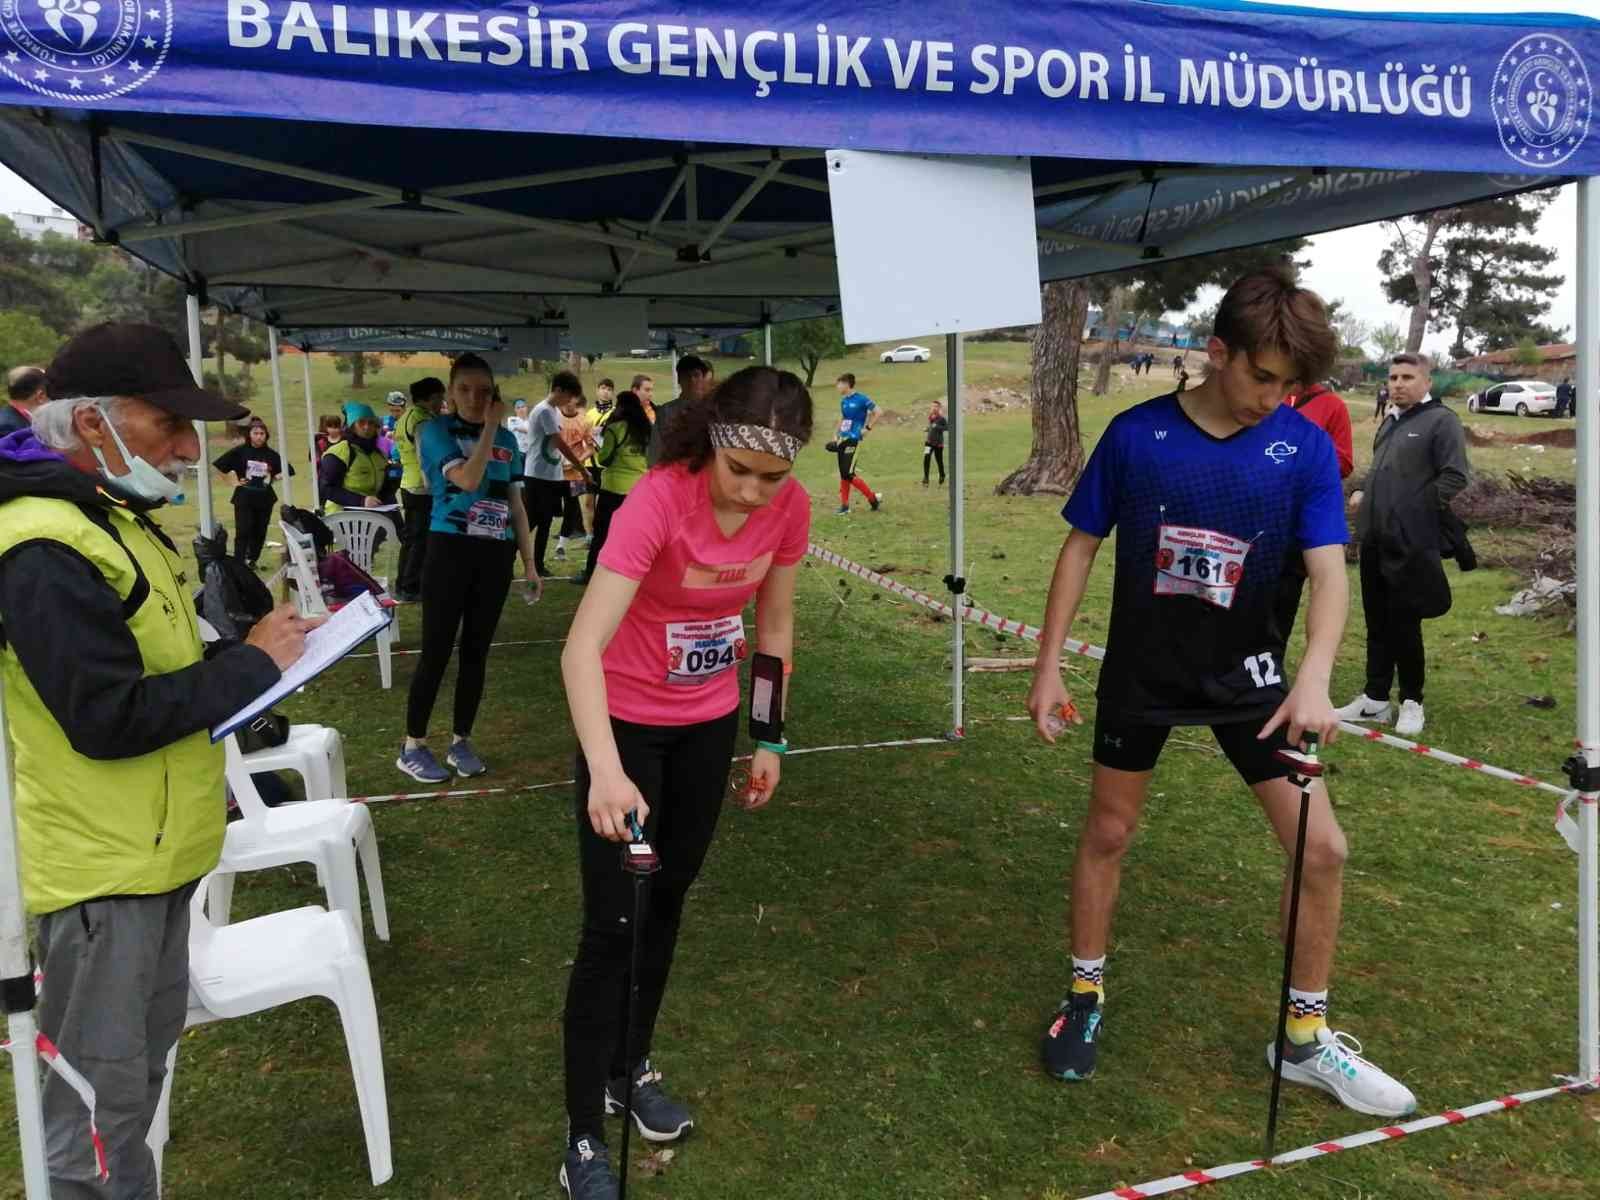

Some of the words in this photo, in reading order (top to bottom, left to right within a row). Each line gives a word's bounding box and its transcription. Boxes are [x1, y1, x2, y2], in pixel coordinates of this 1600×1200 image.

[227, 0, 590, 71] BALIKESİR
[607, 22, 872, 97] GENÇLİK
[883, 38, 954, 92] VE
[969, 44, 1110, 100] SPOR
[1123, 43, 1165, 104] İL
[1178, 51, 1472, 119] MÜDÜRLÜĞÜ
[1177, 555, 1223, 584] 161
[685, 645, 735, 673] 094
[1243, 651, 1282, 689] 12
